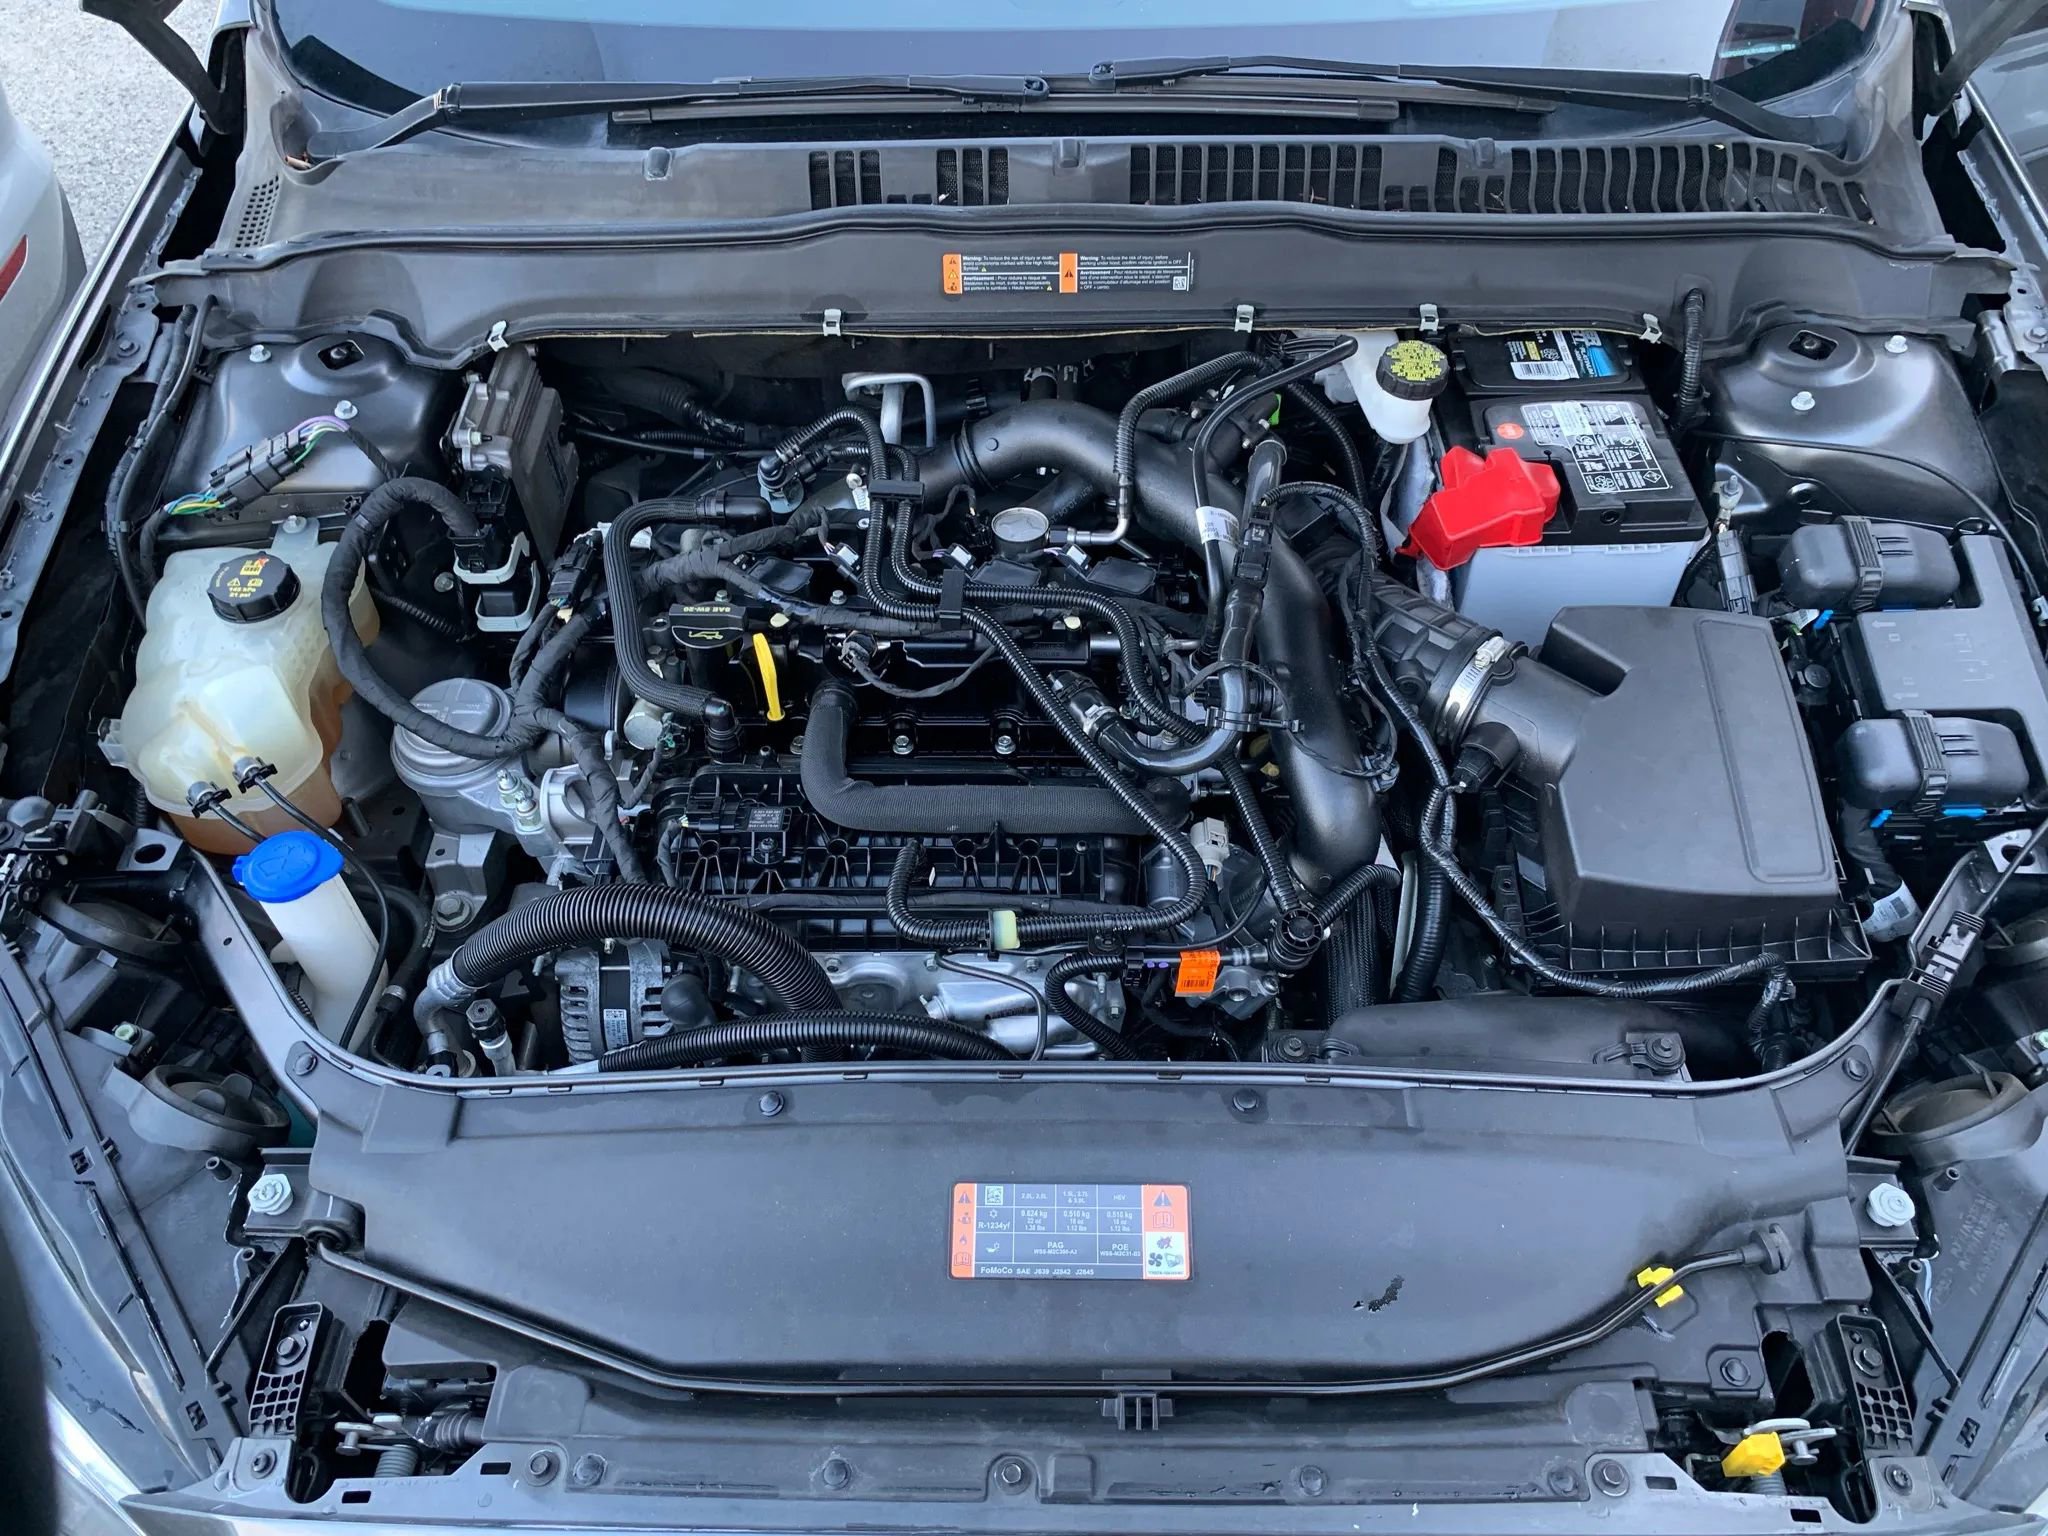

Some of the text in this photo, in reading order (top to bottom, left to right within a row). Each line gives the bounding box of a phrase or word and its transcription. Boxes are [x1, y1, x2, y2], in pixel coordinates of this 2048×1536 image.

[1038, 1210, 1048, 1219] kg
[1081, 1210, 1090, 1219] kg
[1124, 1211, 1133, 1220] kg
[978, 1221, 1010, 1230] R-1234yf
[1048, 1241, 1065, 1249] PAG
[1112, 1243, 1129, 1251] POE
[980, 1266, 1013, 1274] FoMoCo
